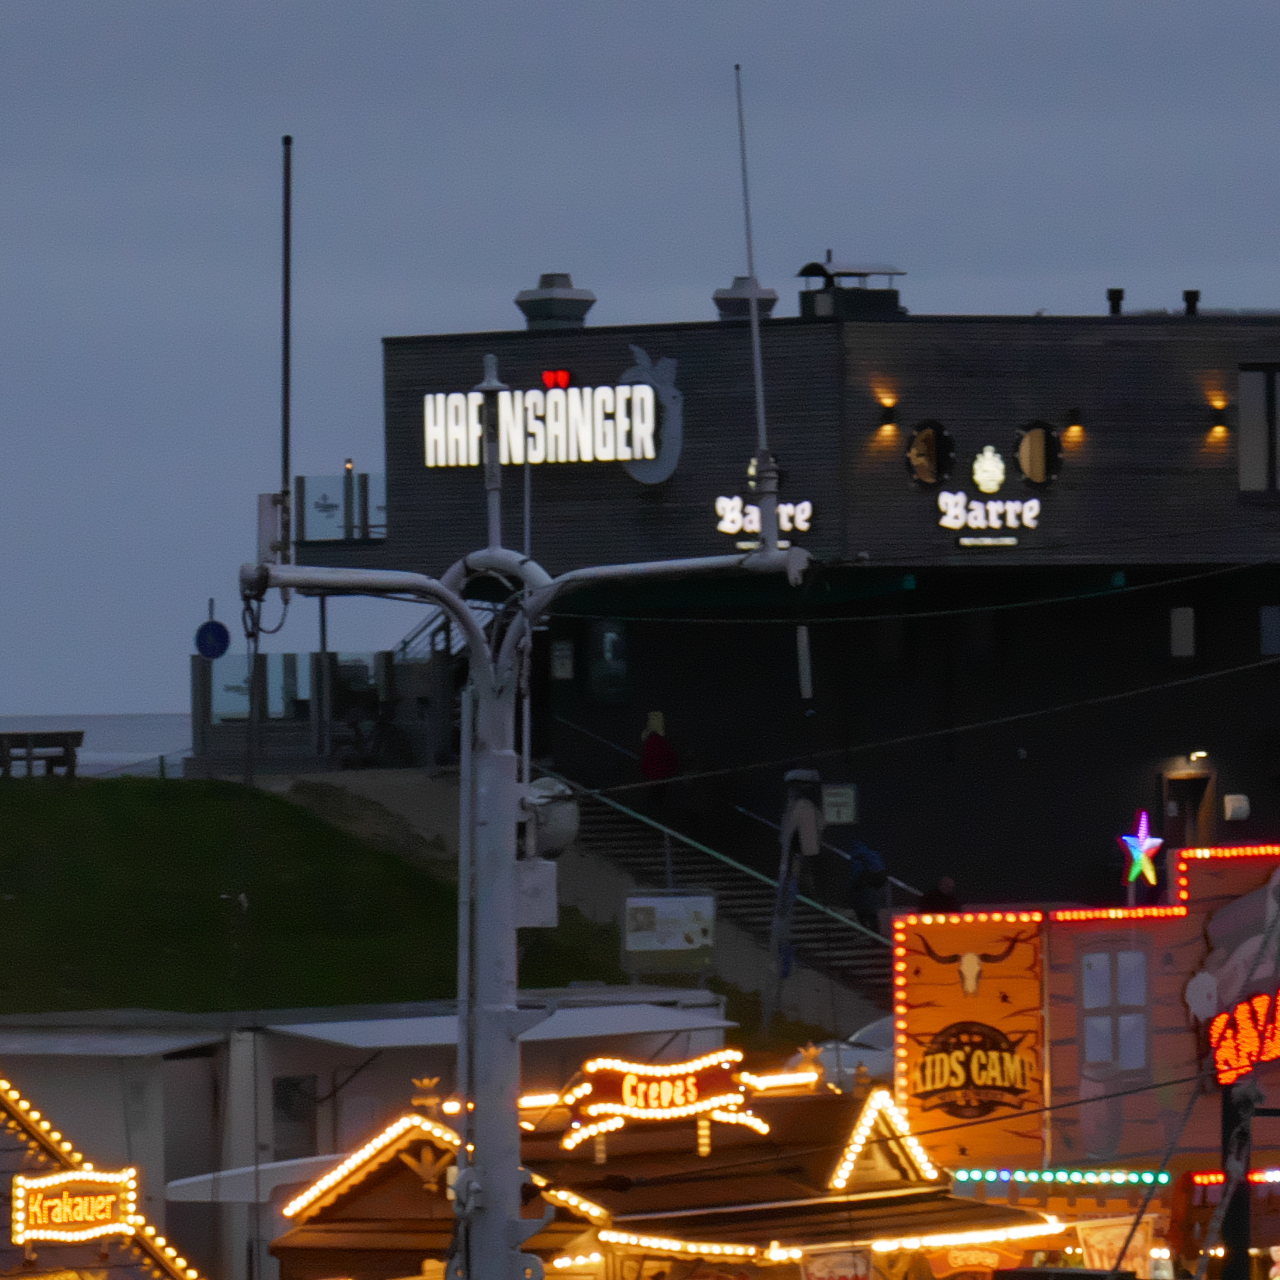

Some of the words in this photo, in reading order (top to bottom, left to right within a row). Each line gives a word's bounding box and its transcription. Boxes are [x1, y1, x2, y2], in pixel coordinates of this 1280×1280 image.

[424, 370, 656, 467] HAFNSÄNGER
[715, 495, 813, 534] Bare
[938, 490, 1040, 531] Barre
[28, 1193, 117, 1225] Krakauer
